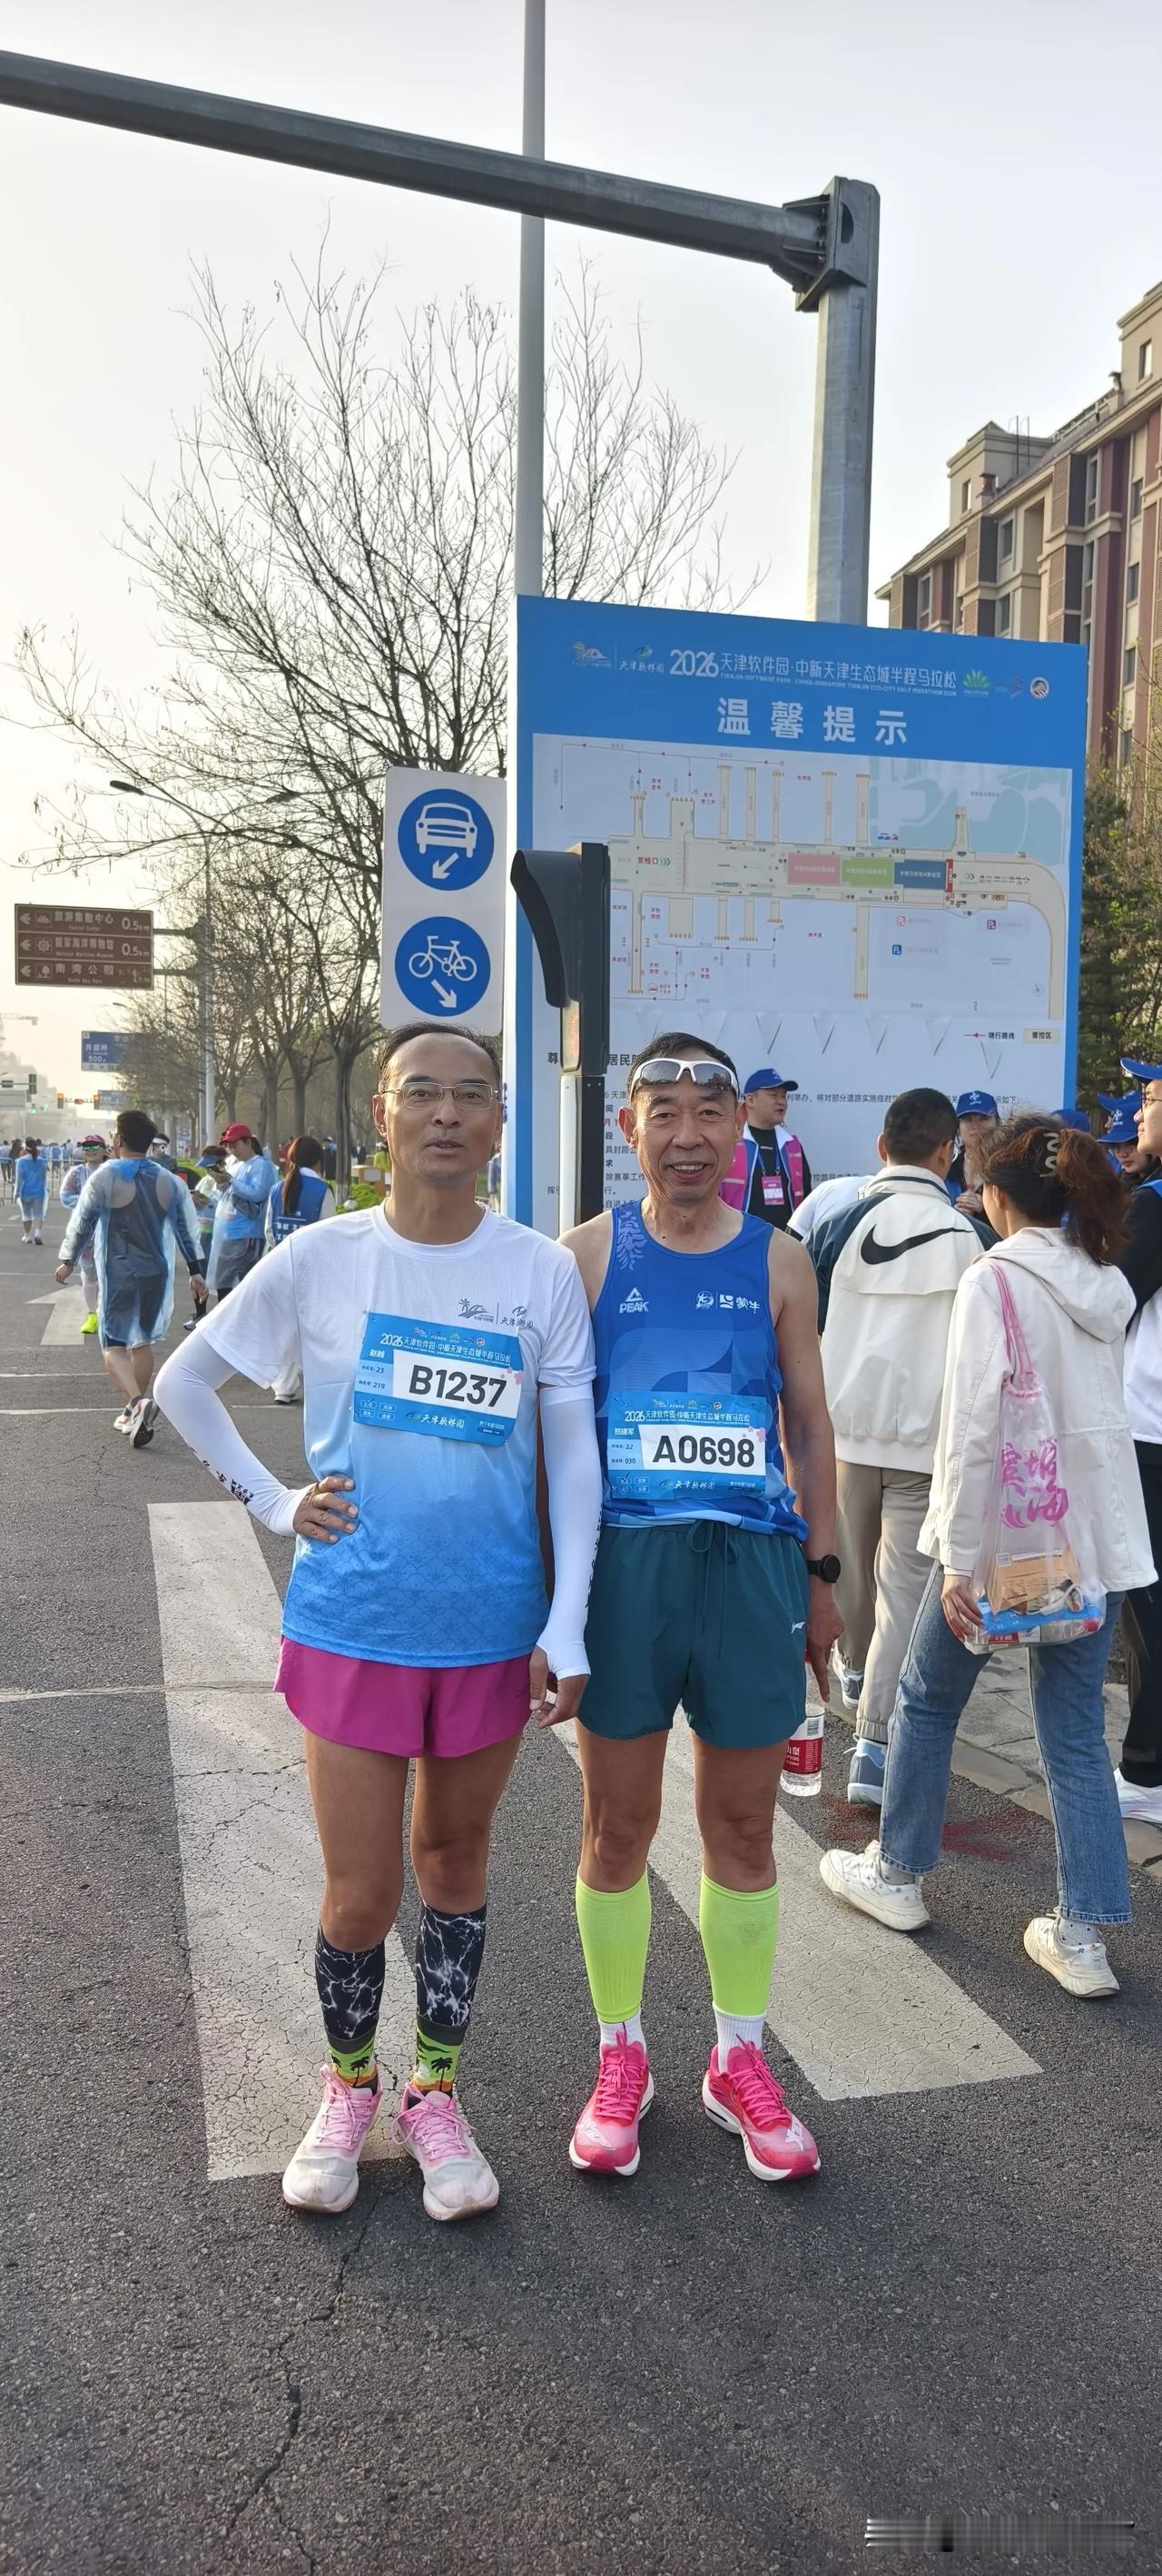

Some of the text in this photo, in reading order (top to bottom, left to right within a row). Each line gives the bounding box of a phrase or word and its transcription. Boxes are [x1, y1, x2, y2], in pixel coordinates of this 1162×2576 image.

[669, 649, 957, 689] 2026 天津软件园·中新天津生态城半程马拉松
[717, 696, 908, 746] 温馨提示
[619, 1301, 650, 1314] PEAK
[736, 1297, 761, 1314] 蒙牛
[380, 1333, 403, 1347] 2026
[373, 1381, 386, 1389] 219
[409, 1365, 507, 1408] B1237
[421, 1414, 465, 1429] 天津软件园
[625, 1410, 645, 1422] 2026
[652, 1435, 755, 1468] A0698
